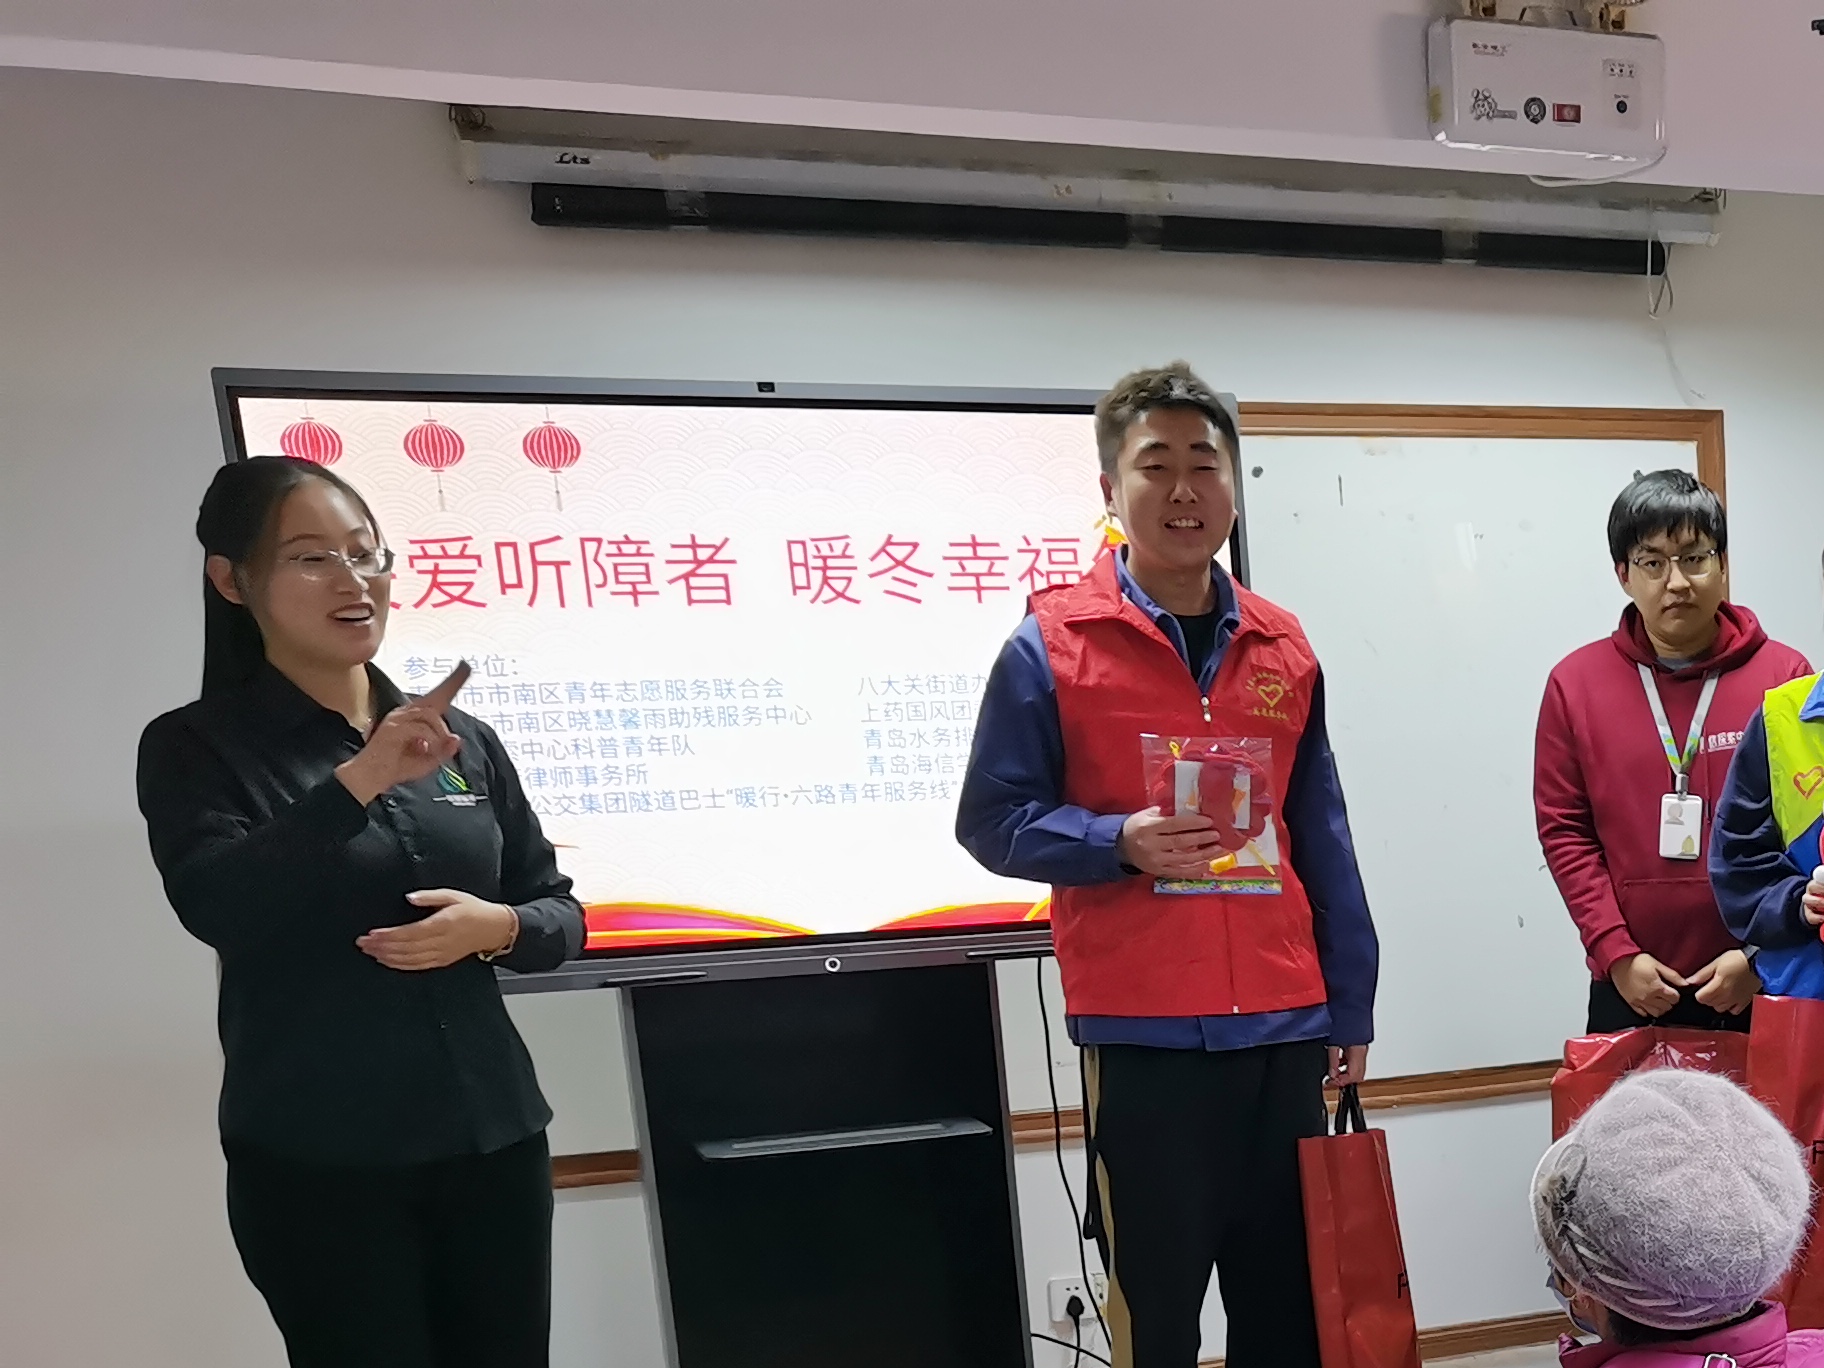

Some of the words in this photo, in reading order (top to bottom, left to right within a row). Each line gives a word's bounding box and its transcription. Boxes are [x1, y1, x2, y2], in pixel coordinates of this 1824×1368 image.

[390, 533, 739, 610] 爱听障者
[785, 533, 1118, 605] 暖冬幸福
[408, 676, 784, 708] 市市南区青年志愿服务联合会
[474, 704, 812, 735] 市南区晓慧馨雨助残服务中心
[860, 700, 979, 723] 上药国风团
[517, 763, 649, 790] 律师事务所
